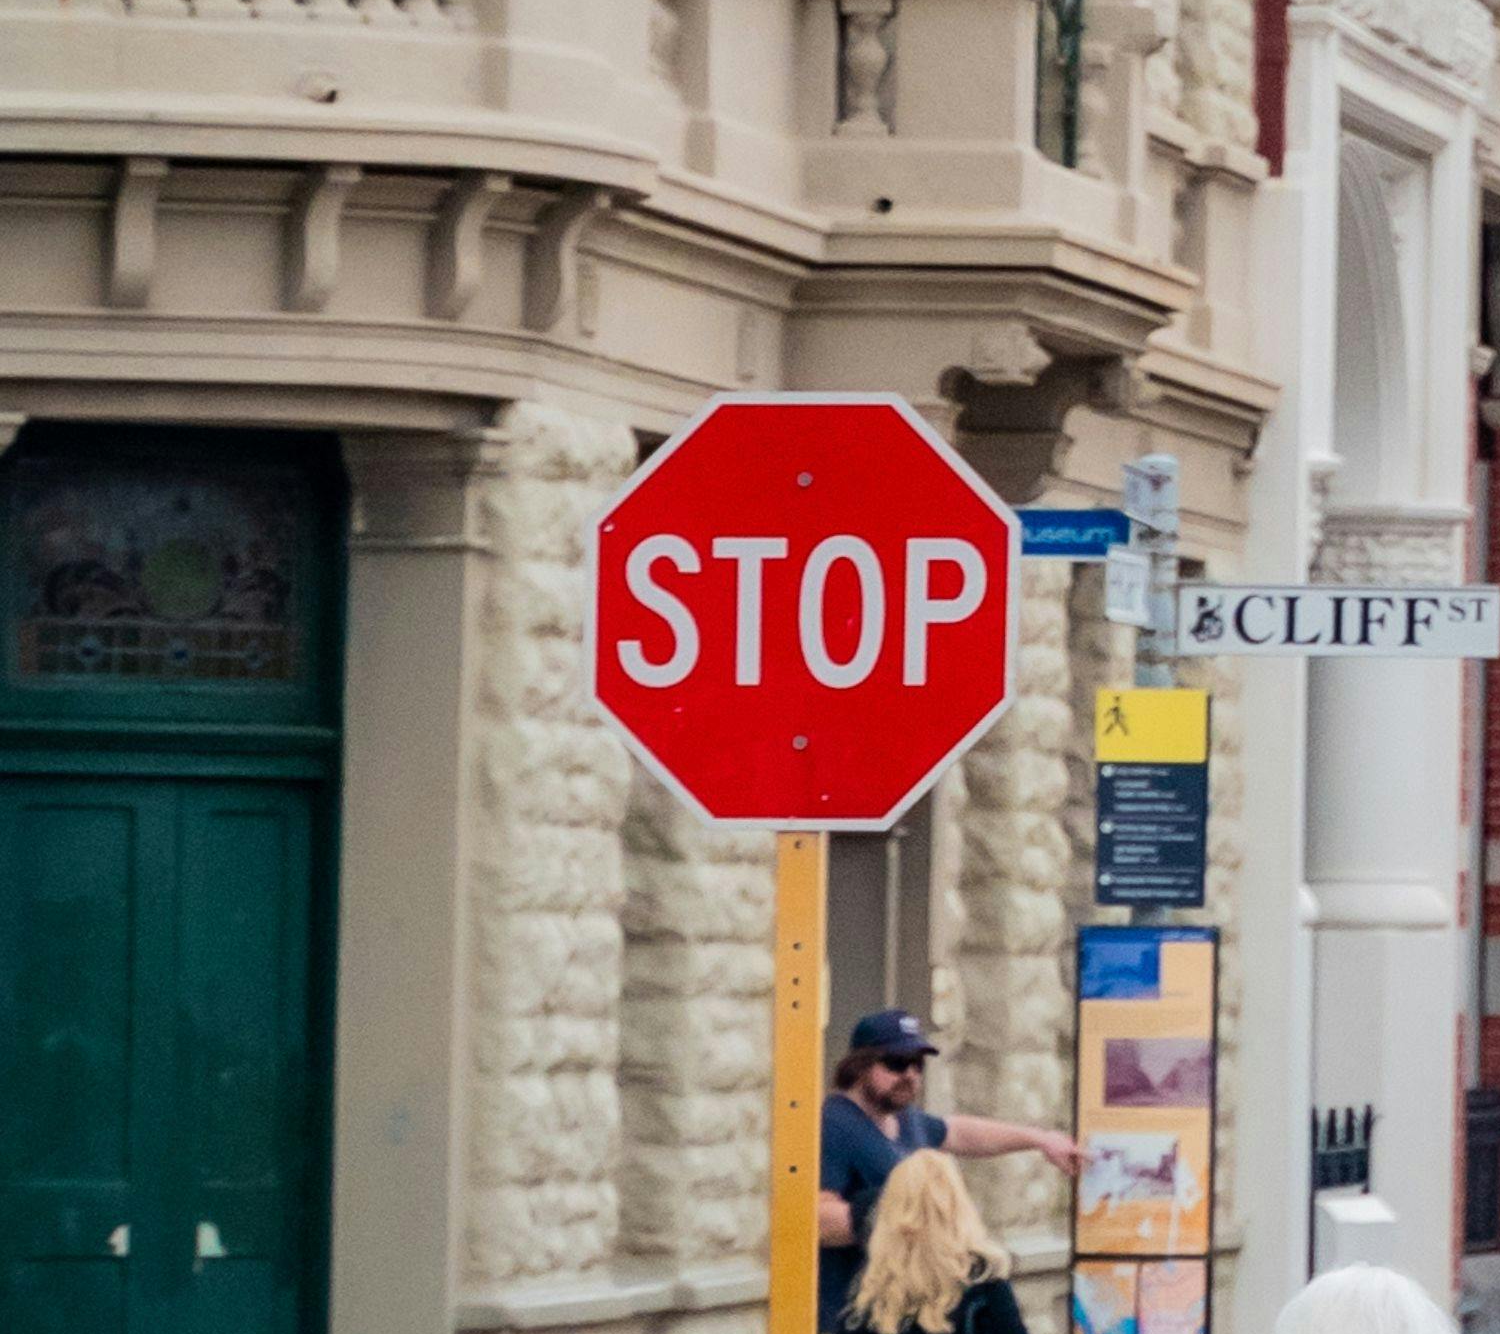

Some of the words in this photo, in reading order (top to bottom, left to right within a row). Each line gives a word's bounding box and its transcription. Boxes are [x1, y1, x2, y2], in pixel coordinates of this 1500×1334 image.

[616, 533, 988, 689] STOP
[1233, 594, 1441, 646] CLIFF
[1447, 597, 1490, 623] ST
